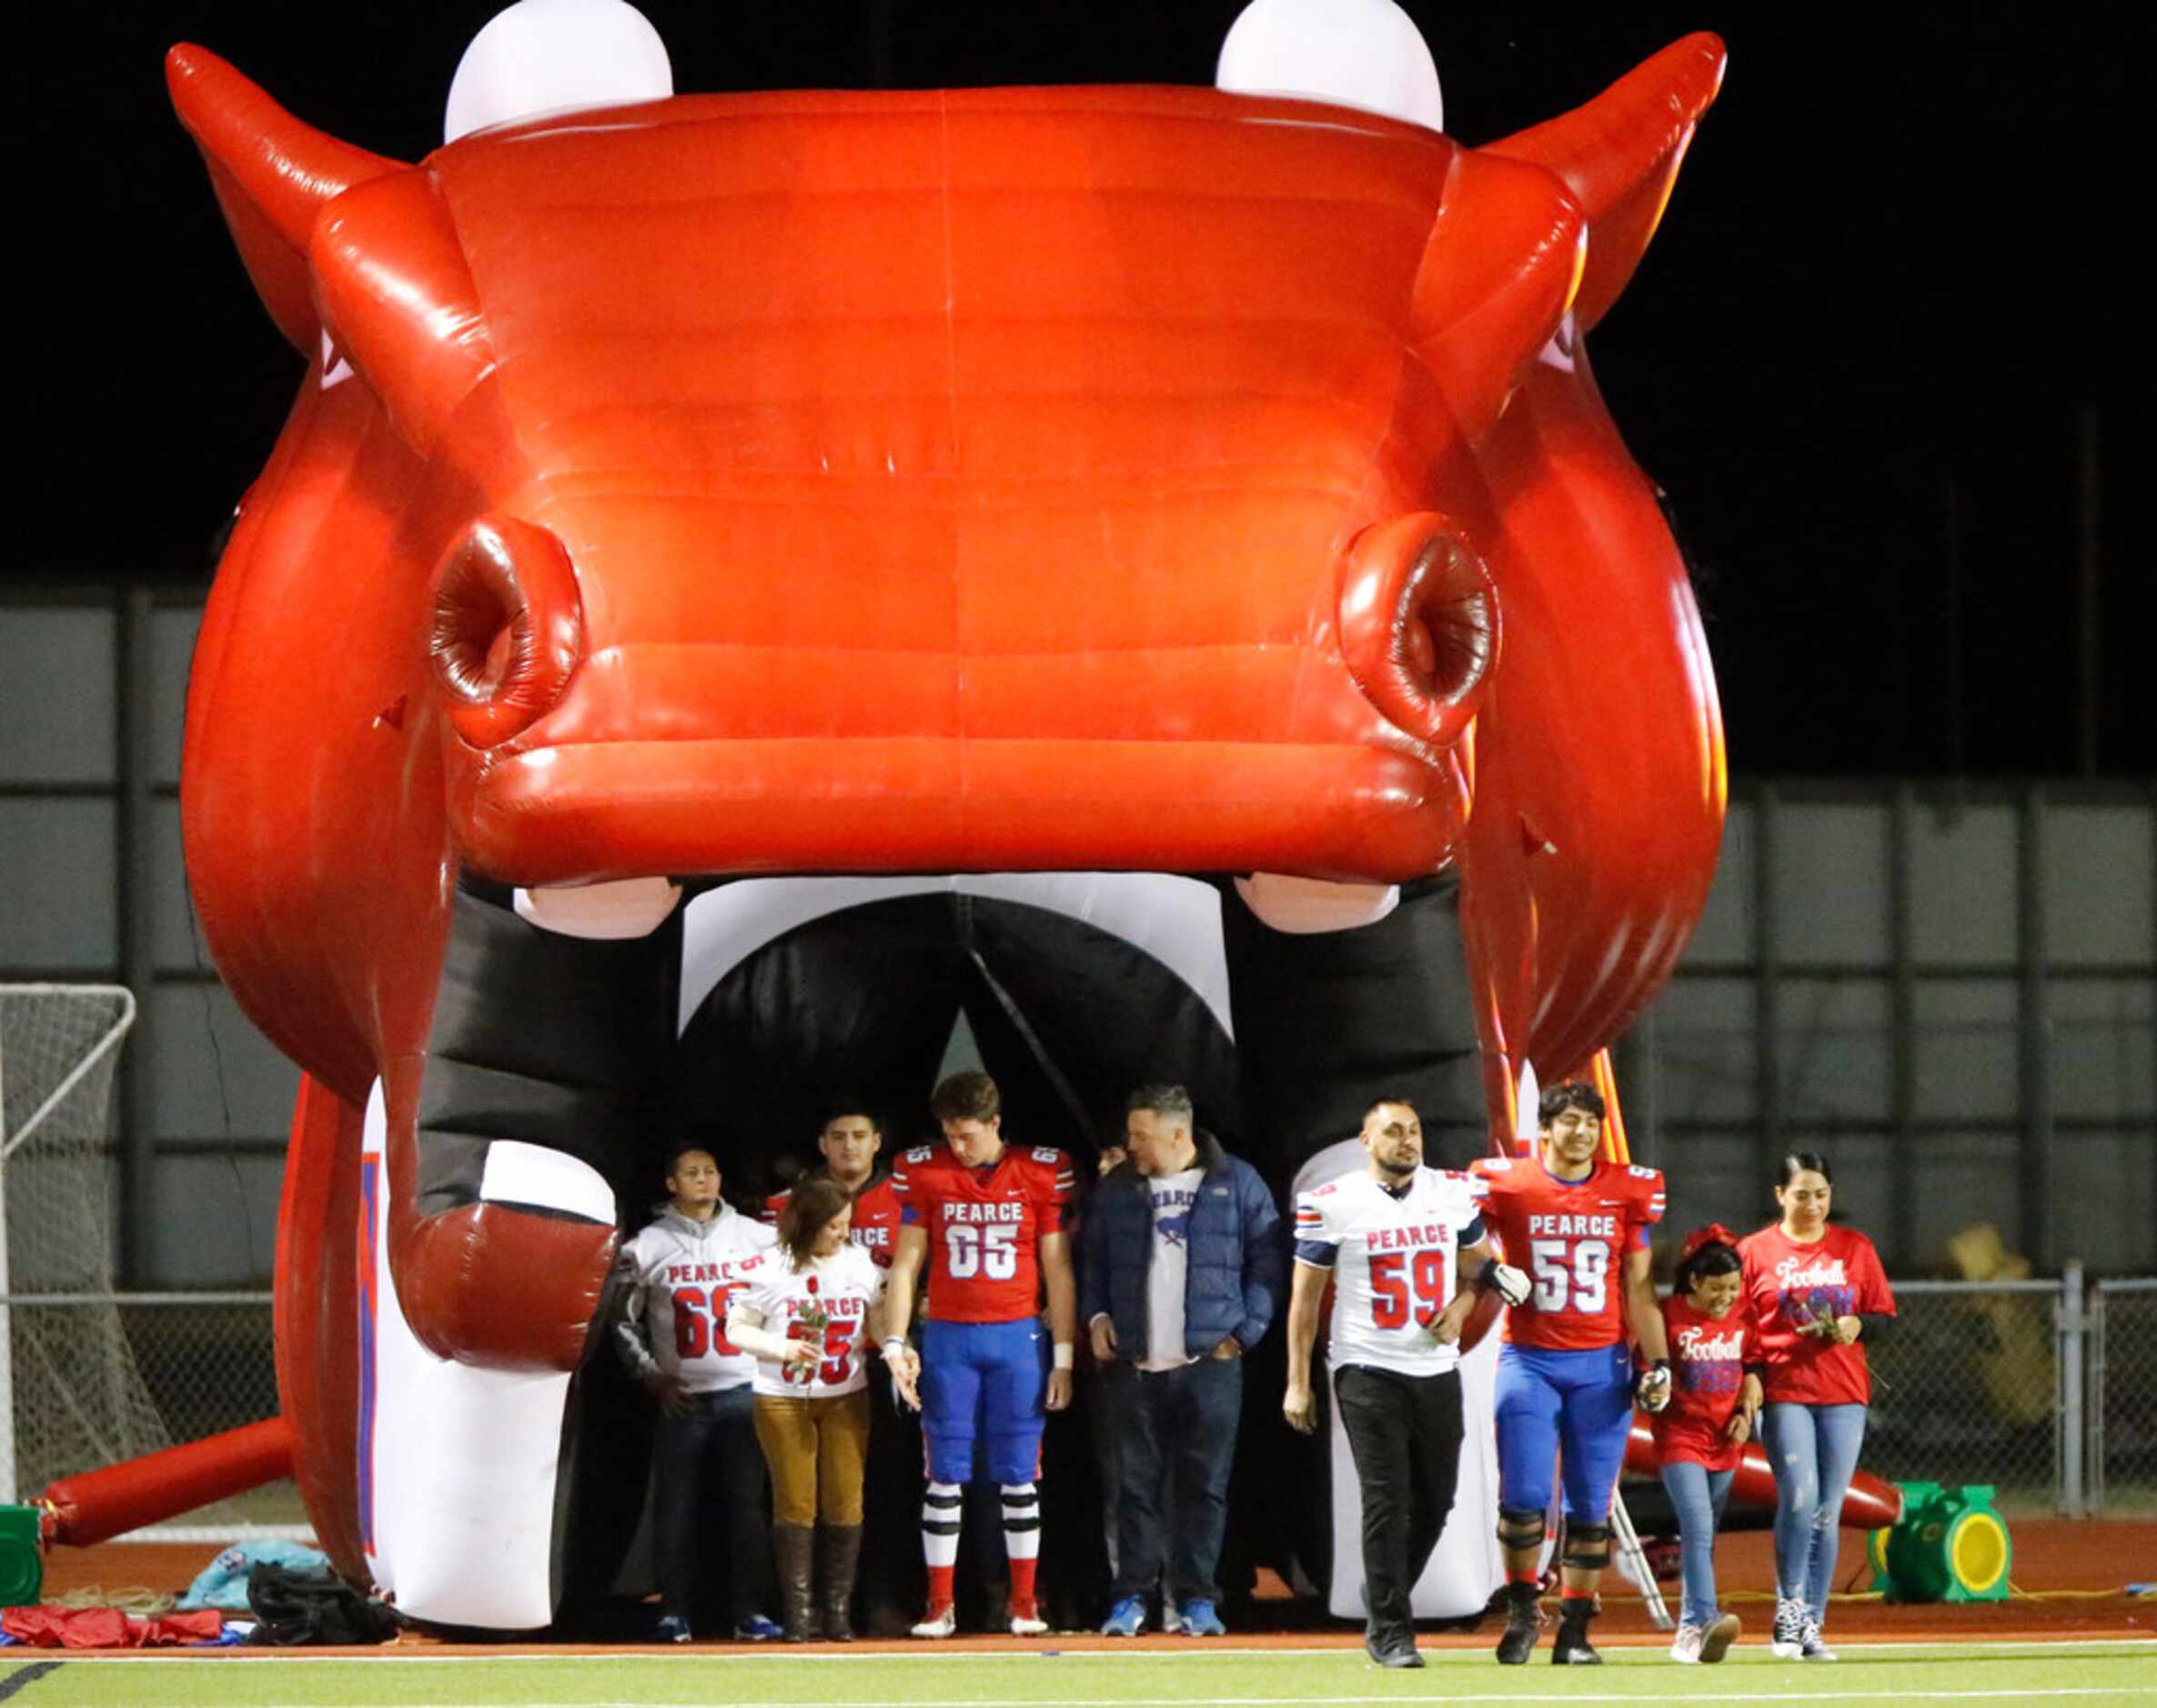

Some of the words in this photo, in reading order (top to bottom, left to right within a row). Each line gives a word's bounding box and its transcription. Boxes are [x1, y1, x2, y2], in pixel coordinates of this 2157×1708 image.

[942, 1202, 1023, 1221] PEARCE
[1150, 1190, 1195, 1210] EARC
[850, 1226, 889, 1246] RCE
[1366, 1222, 1450, 1250] PEARCE
[1528, 1214, 1616, 1237] PEARCE
[945, 1224, 1020, 1281] 65
[669, 1261, 733, 1283] PEARC
[1529, 1239, 1610, 1313] 59
[1775, 1256, 1848, 1289] Football
[1368, 1250, 1446, 1331] 59
[1678, 1325, 1745, 1361] Football
